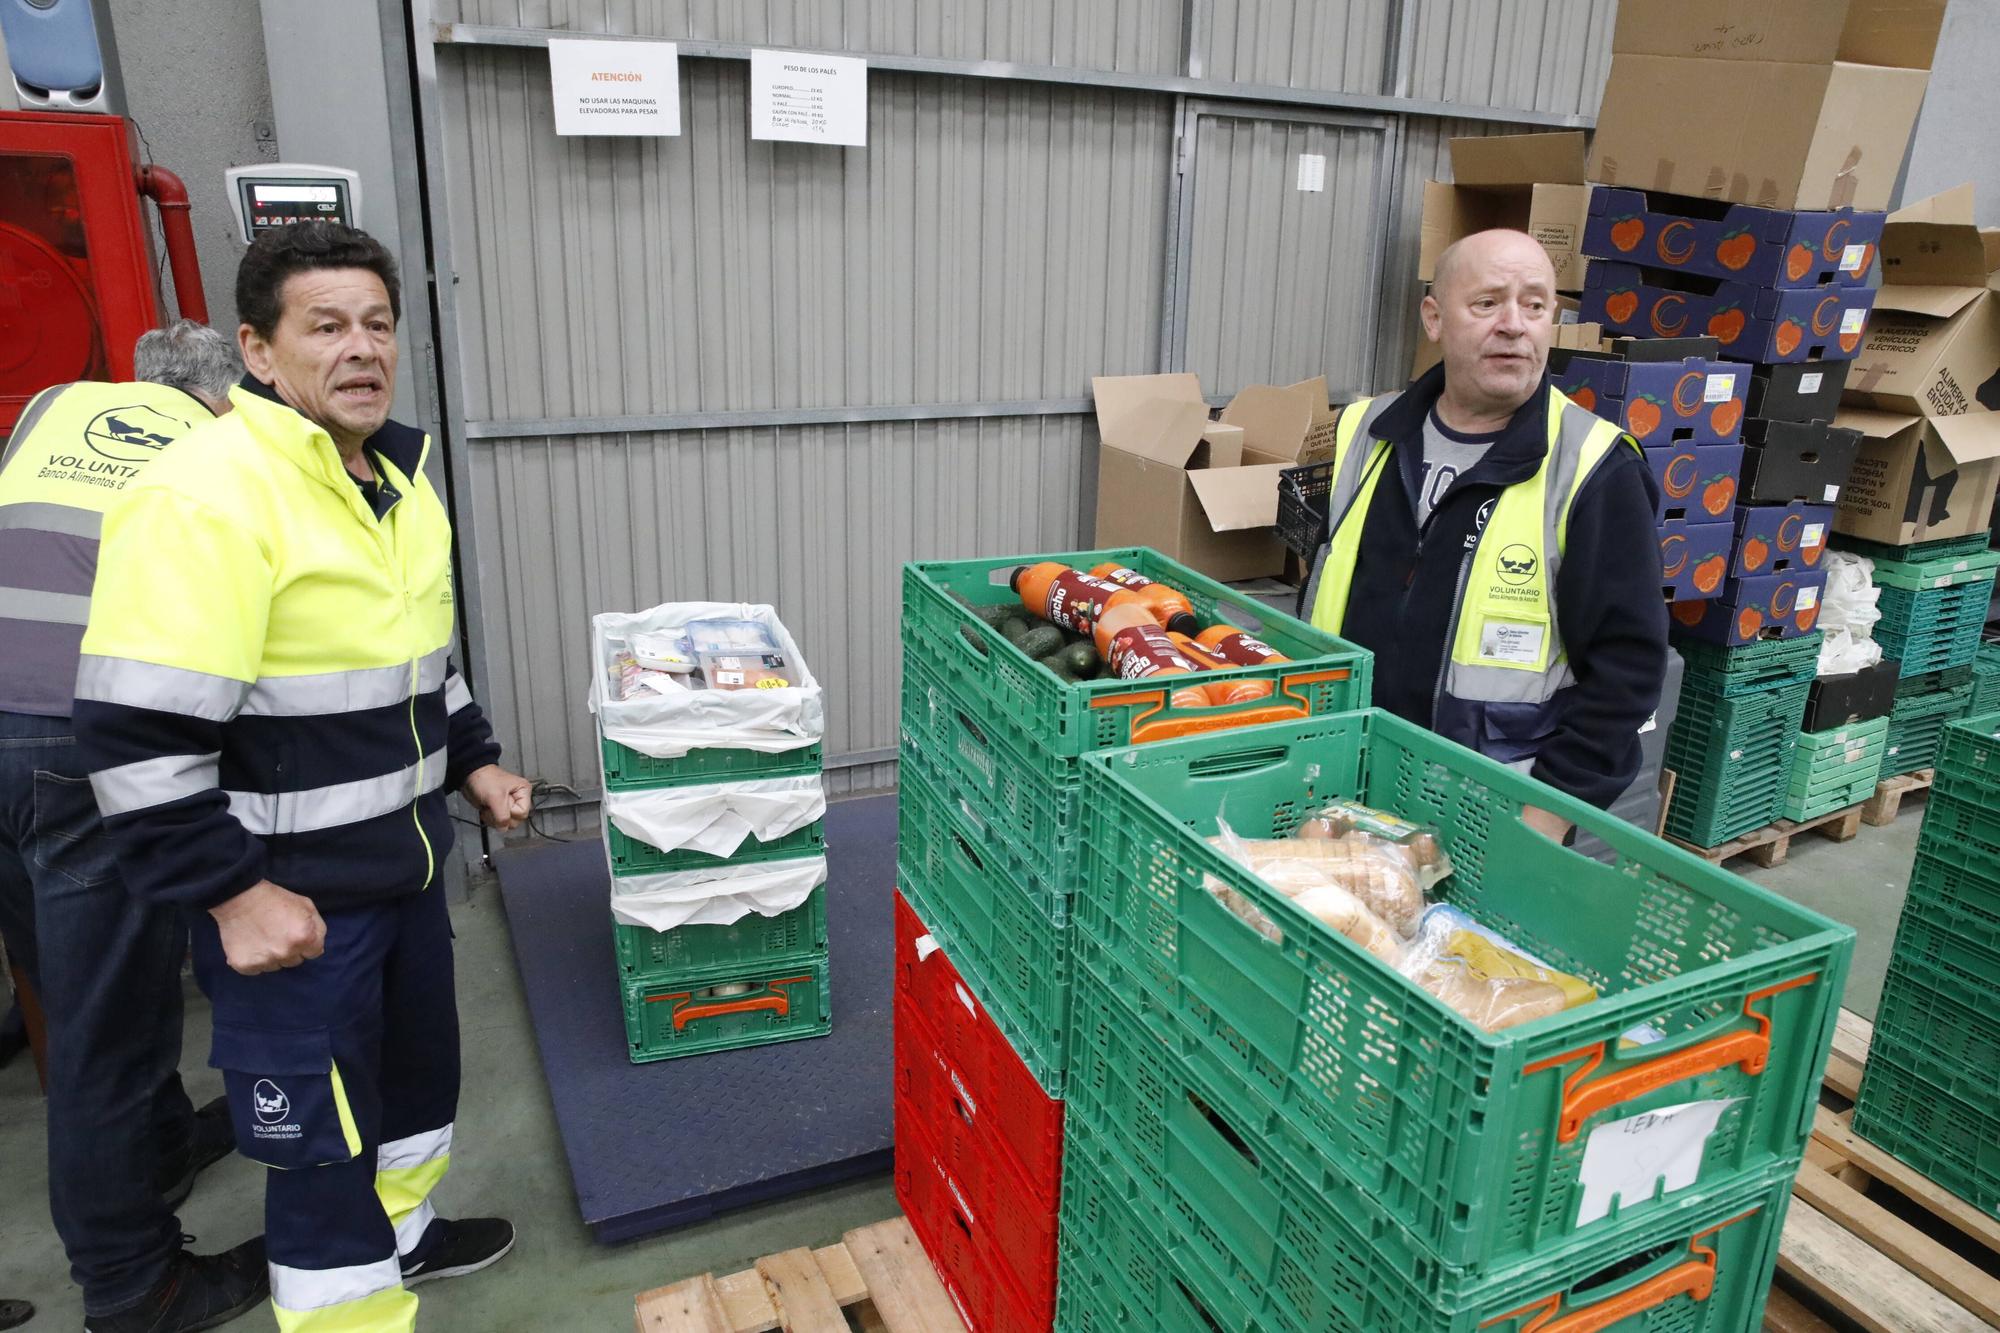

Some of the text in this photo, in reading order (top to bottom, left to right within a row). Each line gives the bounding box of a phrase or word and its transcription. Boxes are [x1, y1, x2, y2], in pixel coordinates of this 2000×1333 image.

[784, 64, 798, 72] PESO
[592, 70, 642, 82] ATENCIÓN
[1873, 335, 1921, 345] VEHÍCULOS
[1865, 343, 1917, 353] ELÉCTRICOS
[1938, 367, 1969, 414] ALIMERKA
[1935, 381, 1955, 412] CUIDA
[38, 467, 68, 479] Banco
[68, 471, 116, 489] Alimentos
[1466, 534, 1477, 543] VO
[1490, 586, 1540, 596] VOLUNTARIO
[252, 1124, 301, 1133] VOLUNTARIO
